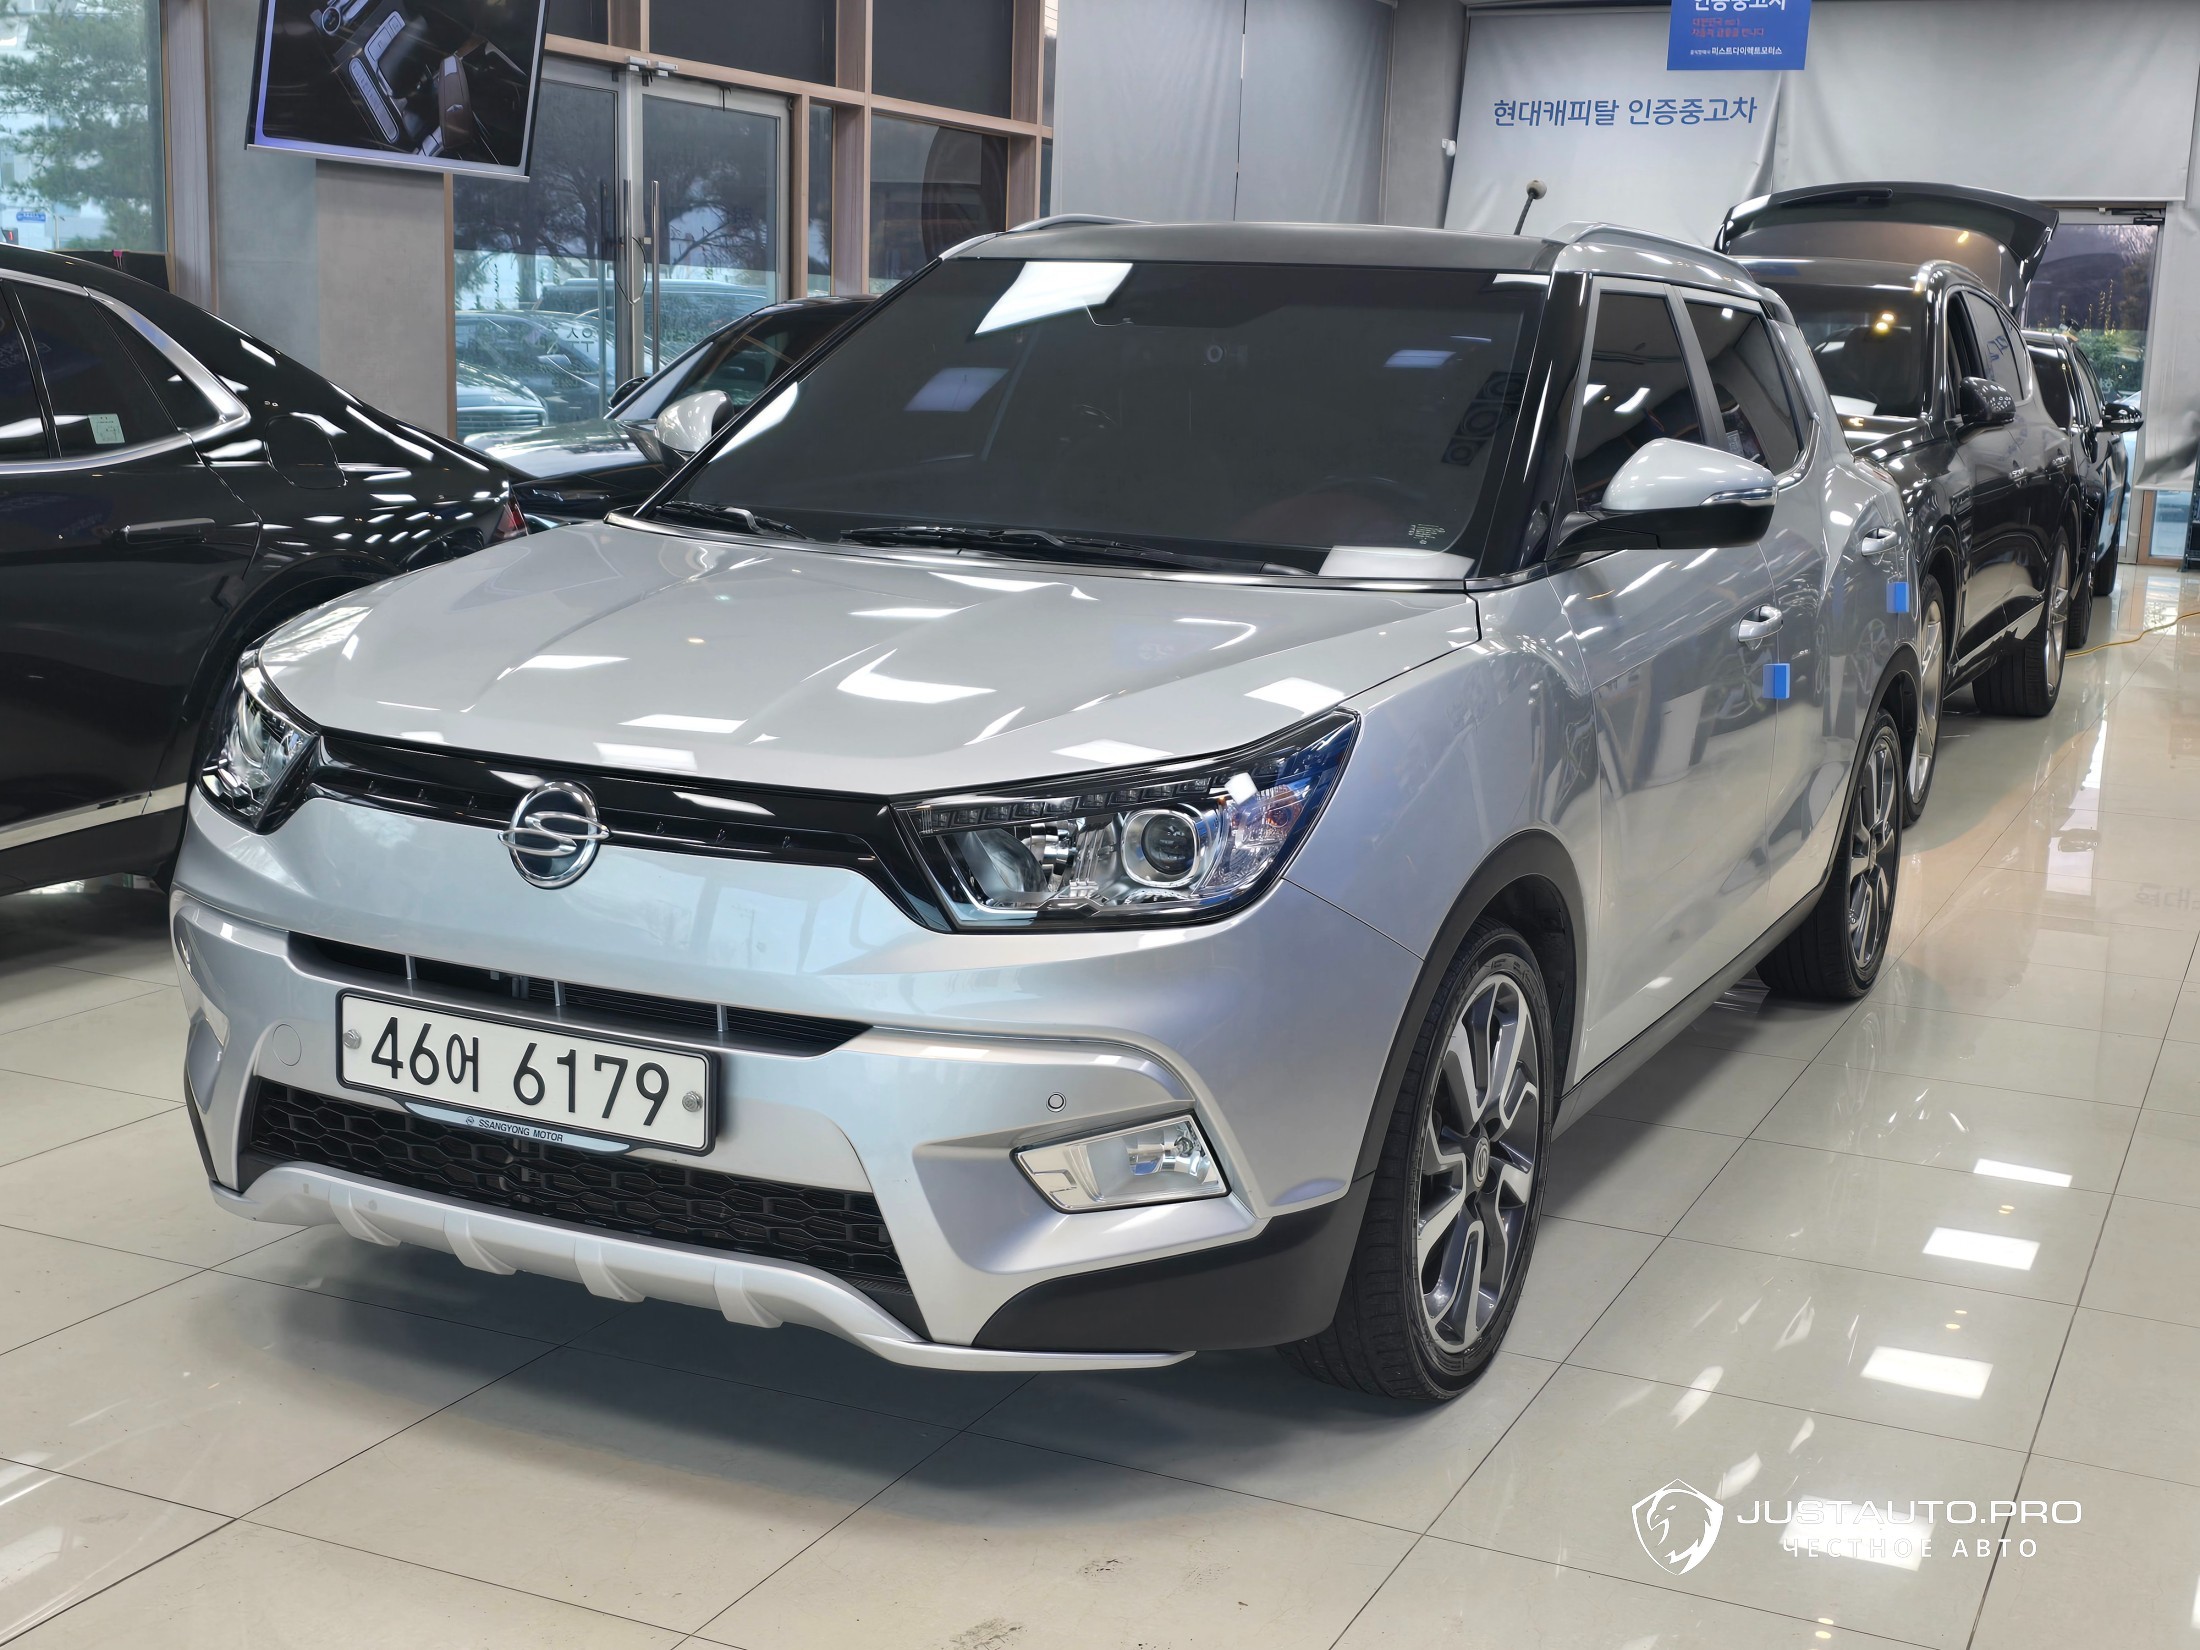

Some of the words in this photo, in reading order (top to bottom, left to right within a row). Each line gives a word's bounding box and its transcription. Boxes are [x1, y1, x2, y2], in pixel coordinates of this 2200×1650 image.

[1493, 98, 1620, 127] 현대캐피탈
[1628, 96, 1758, 126] 인증중고차
[370, 1016, 480, 1093] 46어
[512, 1042, 671, 1127] 6179
[478, 1118, 530, 1136] SSANGYONG
[533, 1129, 564, 1143] MOTOR
